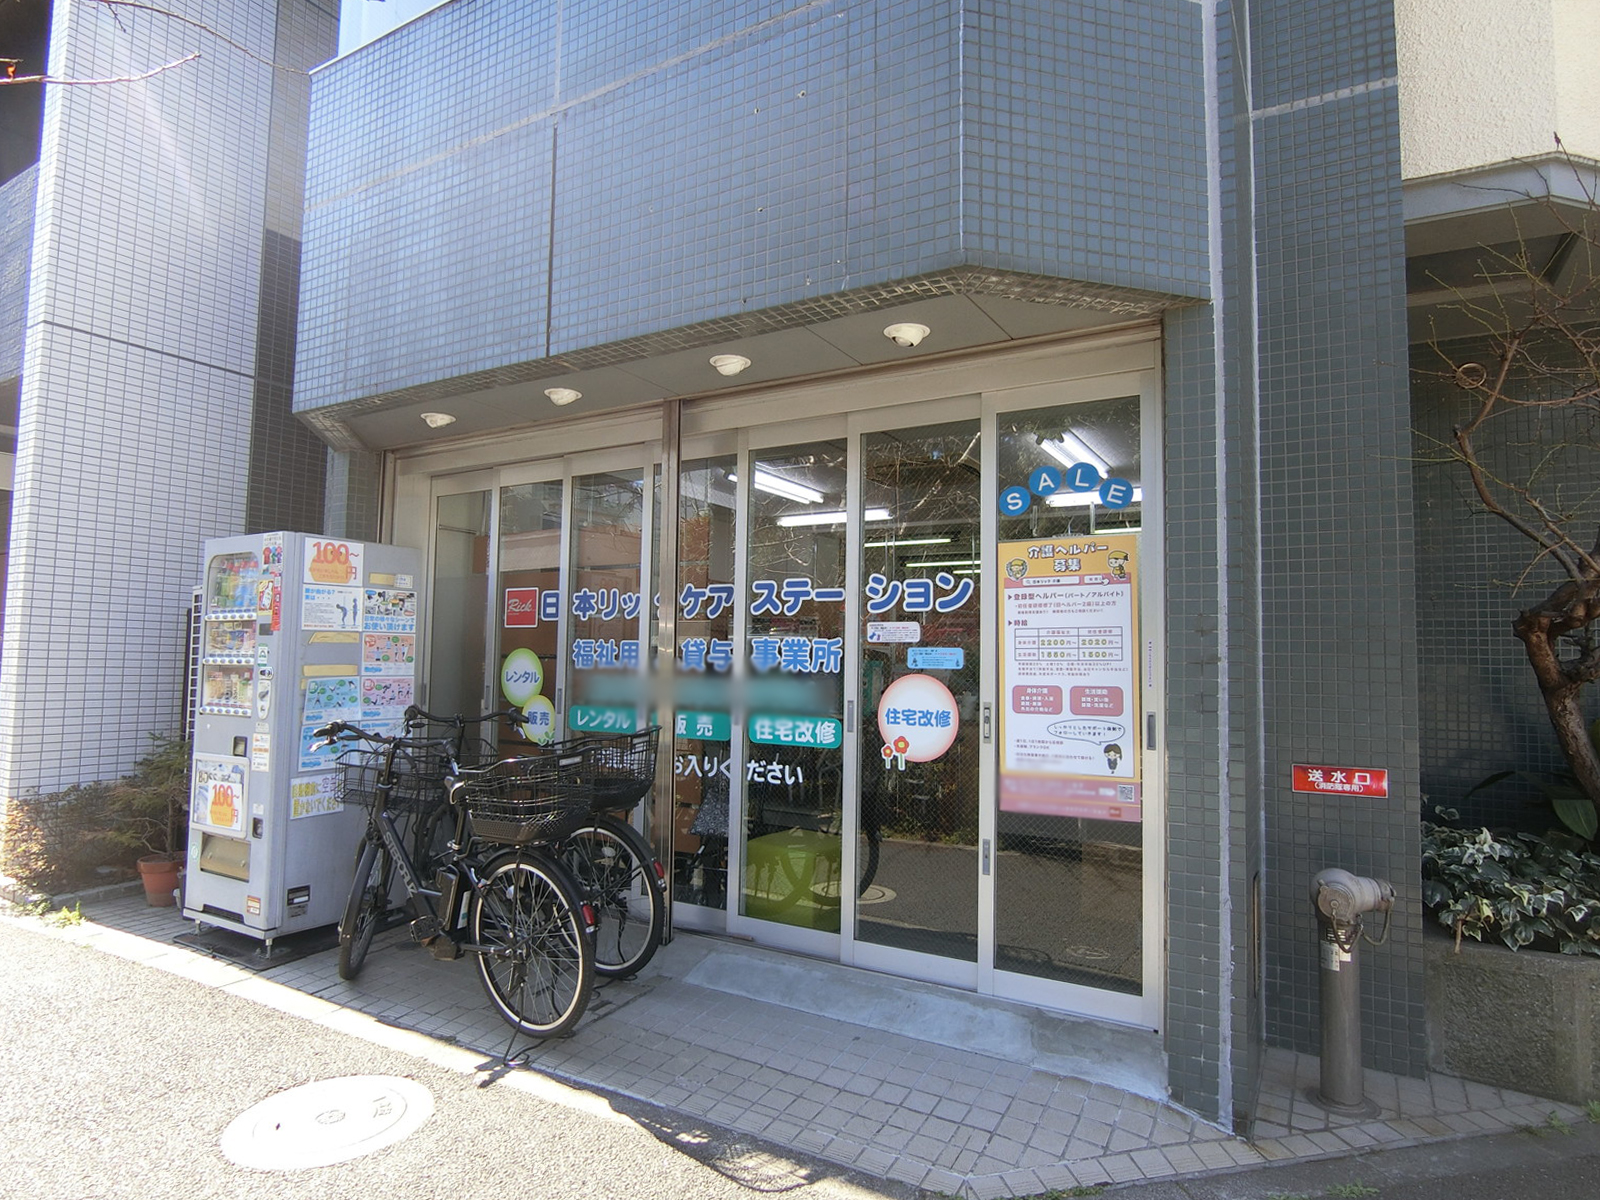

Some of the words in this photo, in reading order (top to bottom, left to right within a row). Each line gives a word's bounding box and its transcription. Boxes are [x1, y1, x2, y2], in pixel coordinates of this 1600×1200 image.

[1006, 468, 1127, 510] SALE
[1027, 541, 1108, 560] 介護ヘルパー
[1053, 558, 1082, 573] 募集
[507, 598, 532, 613] Rick
[504, 670, 540, 684] レンタル
[528, 711, 550, 726] 販売
[577, 709, 631, 729] レンタル
[885, 708, 952, 728] 住宅改修
[754, 718, 836, 744] 住宅改修
[1308, 768, 1370, 785] 送水口
